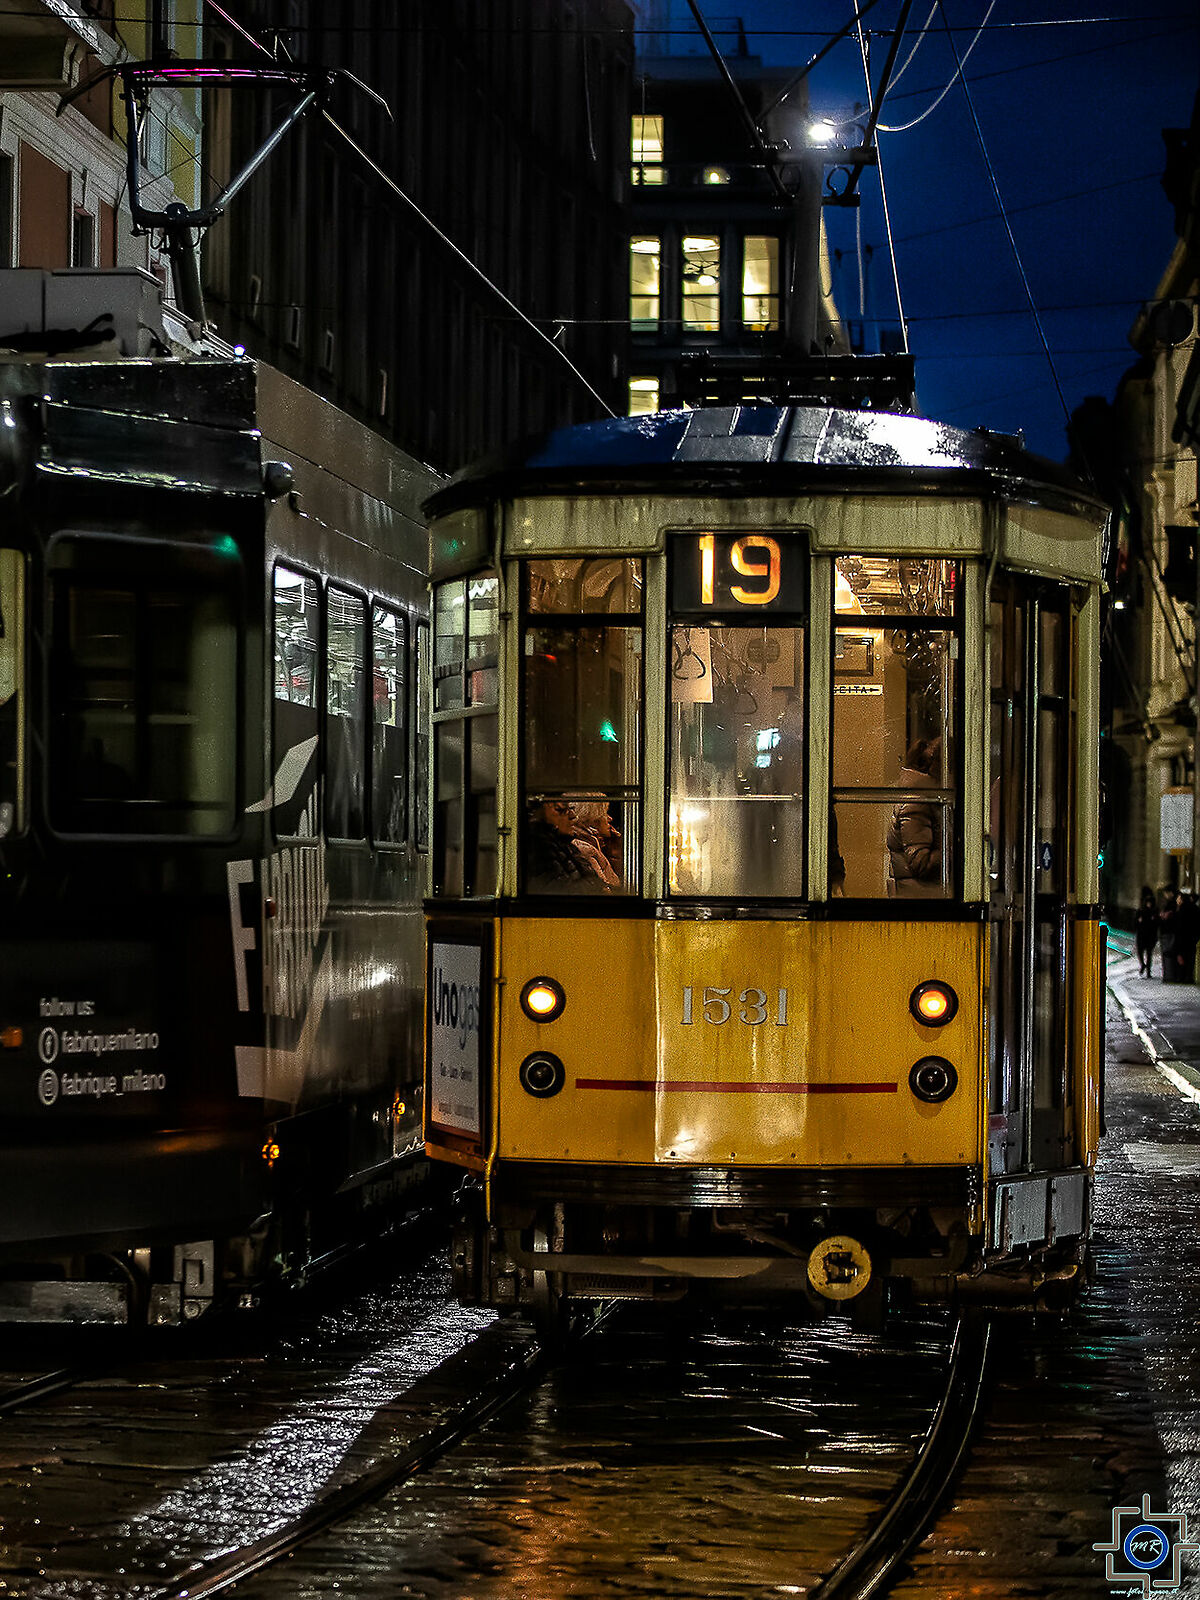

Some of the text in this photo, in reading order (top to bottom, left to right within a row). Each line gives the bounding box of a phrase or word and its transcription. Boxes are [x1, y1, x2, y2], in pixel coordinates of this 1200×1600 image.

[698, 534, 781, 605] 19
[680, 986, 789, 1026] 1531
[61, 1028, 160, 1057] fabriquemilano
[61, 1069, 167, 1099] fabrique_milano
